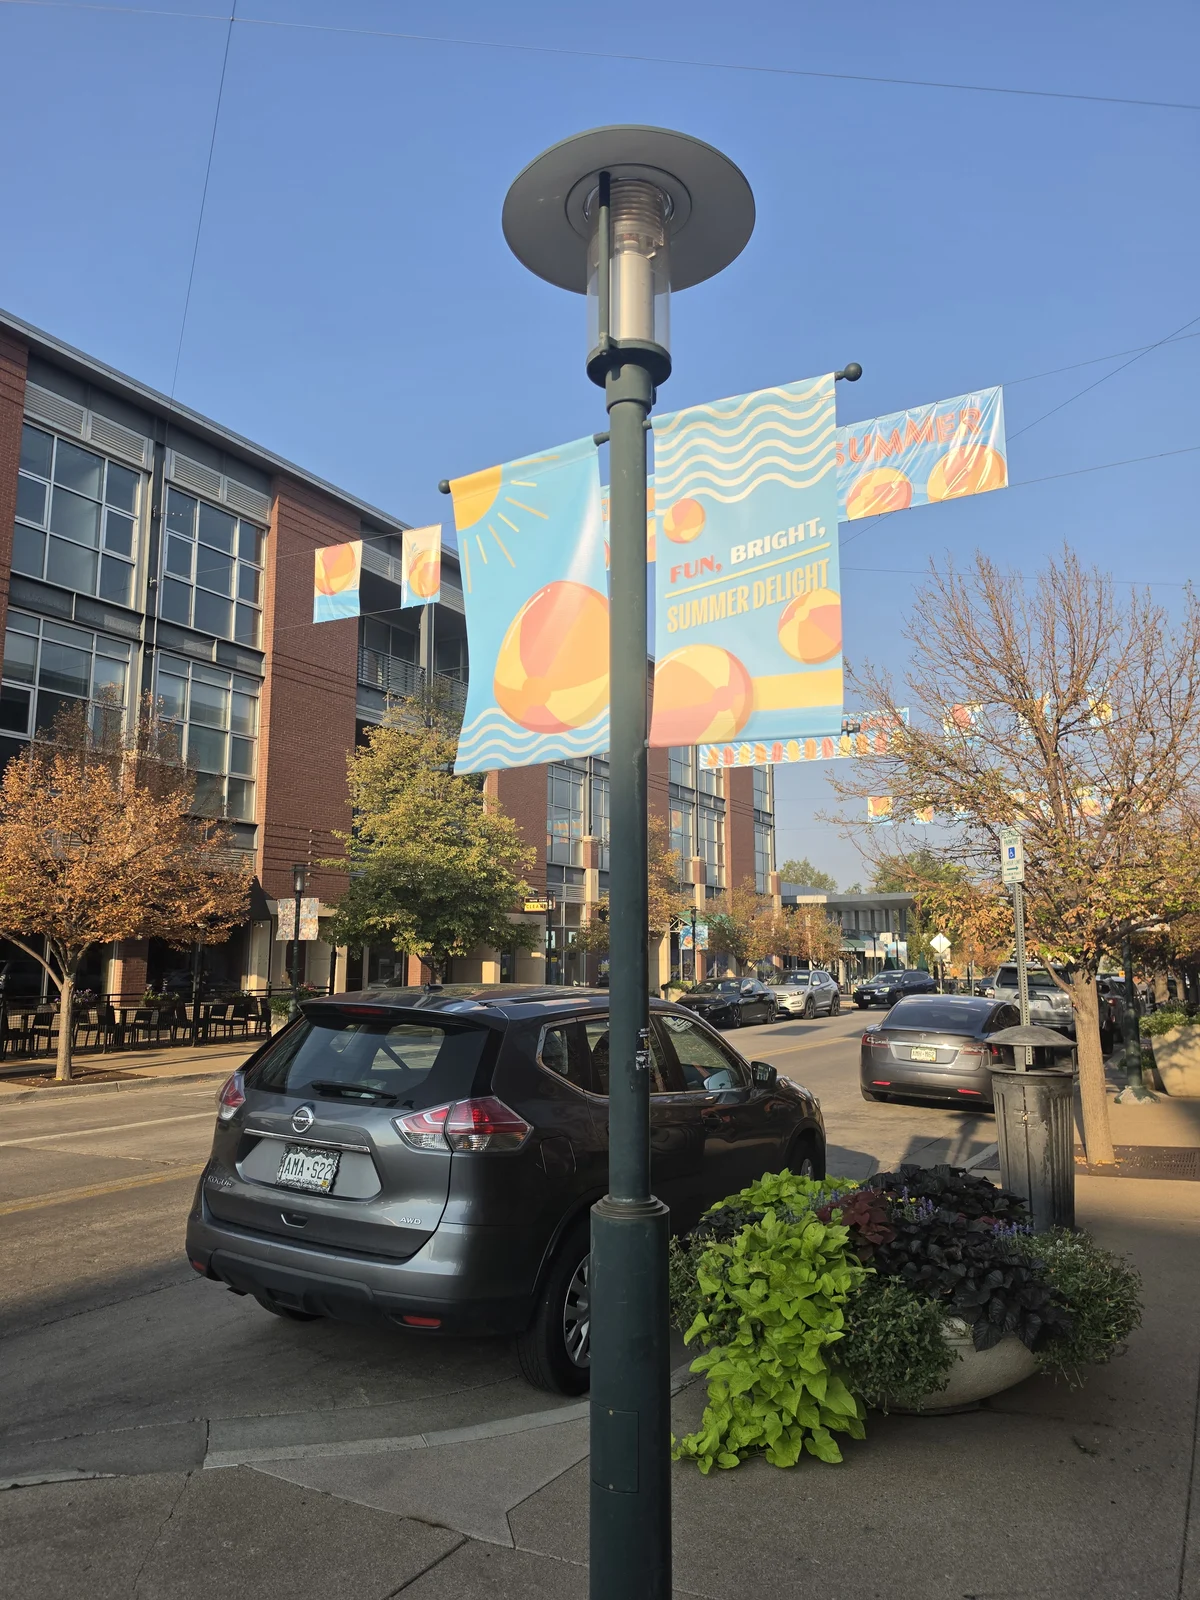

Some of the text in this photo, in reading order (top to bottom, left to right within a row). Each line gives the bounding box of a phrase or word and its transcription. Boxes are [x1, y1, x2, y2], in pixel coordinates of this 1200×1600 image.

[669, 517, 826, 584] FUN, BRIGHT,
[667, 558, 830, 633] SUMMER DELIGHT
[207, 1175, 233, 1187] ROGUE
[399, 1216, 422, 1226] AWD
